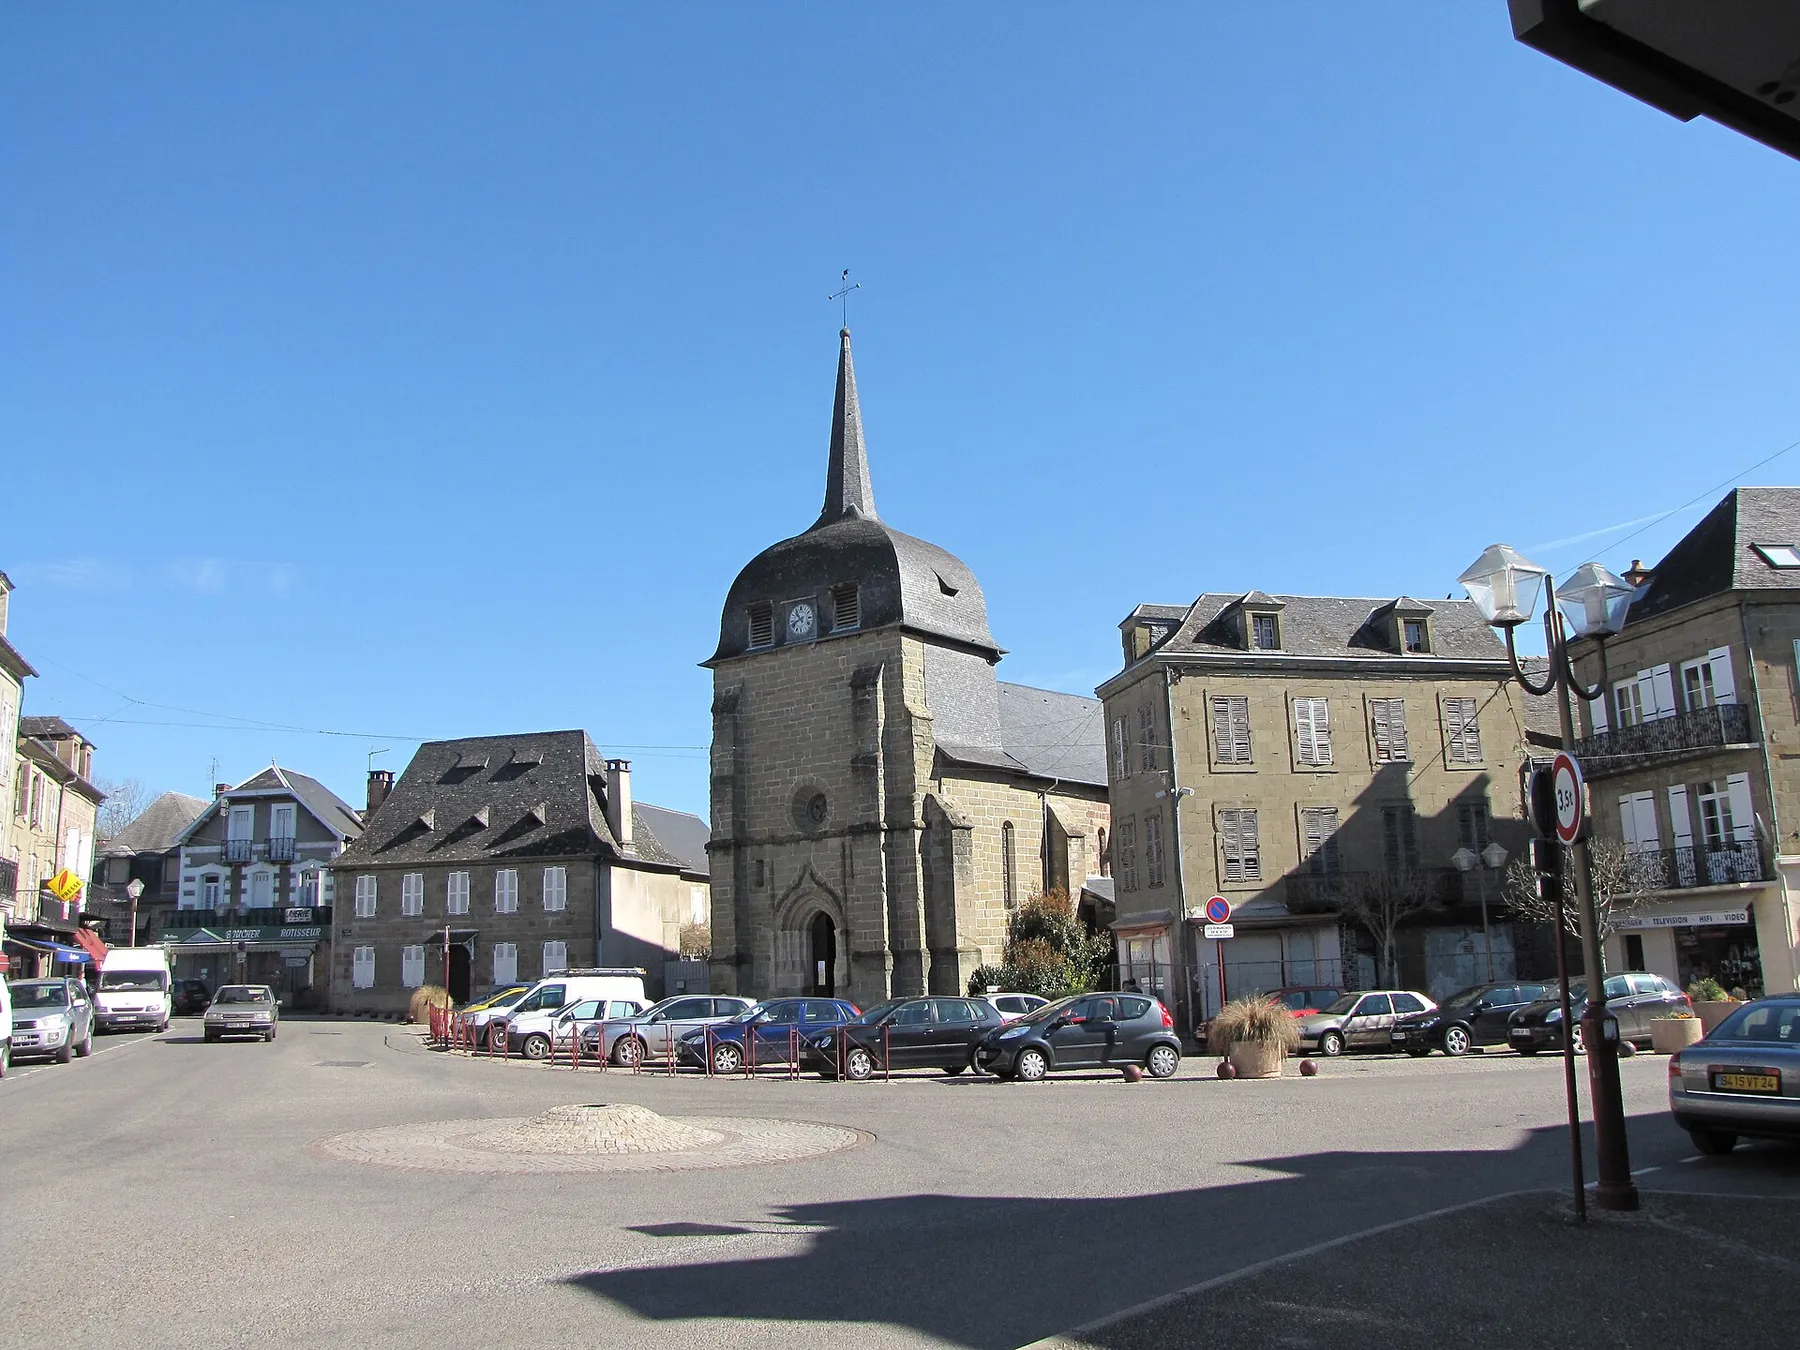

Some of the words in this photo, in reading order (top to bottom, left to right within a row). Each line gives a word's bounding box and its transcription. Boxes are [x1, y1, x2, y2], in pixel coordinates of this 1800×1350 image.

[1557, 788, 1573, 813] 3,5t
[60, 880, 81, 899] PRESSE
[1652, 916, 1688, 925] TELEVISION
[1723, 913, 1746, 921] VIDEO
[280, 927, 322, 938] ROTISSEUR
